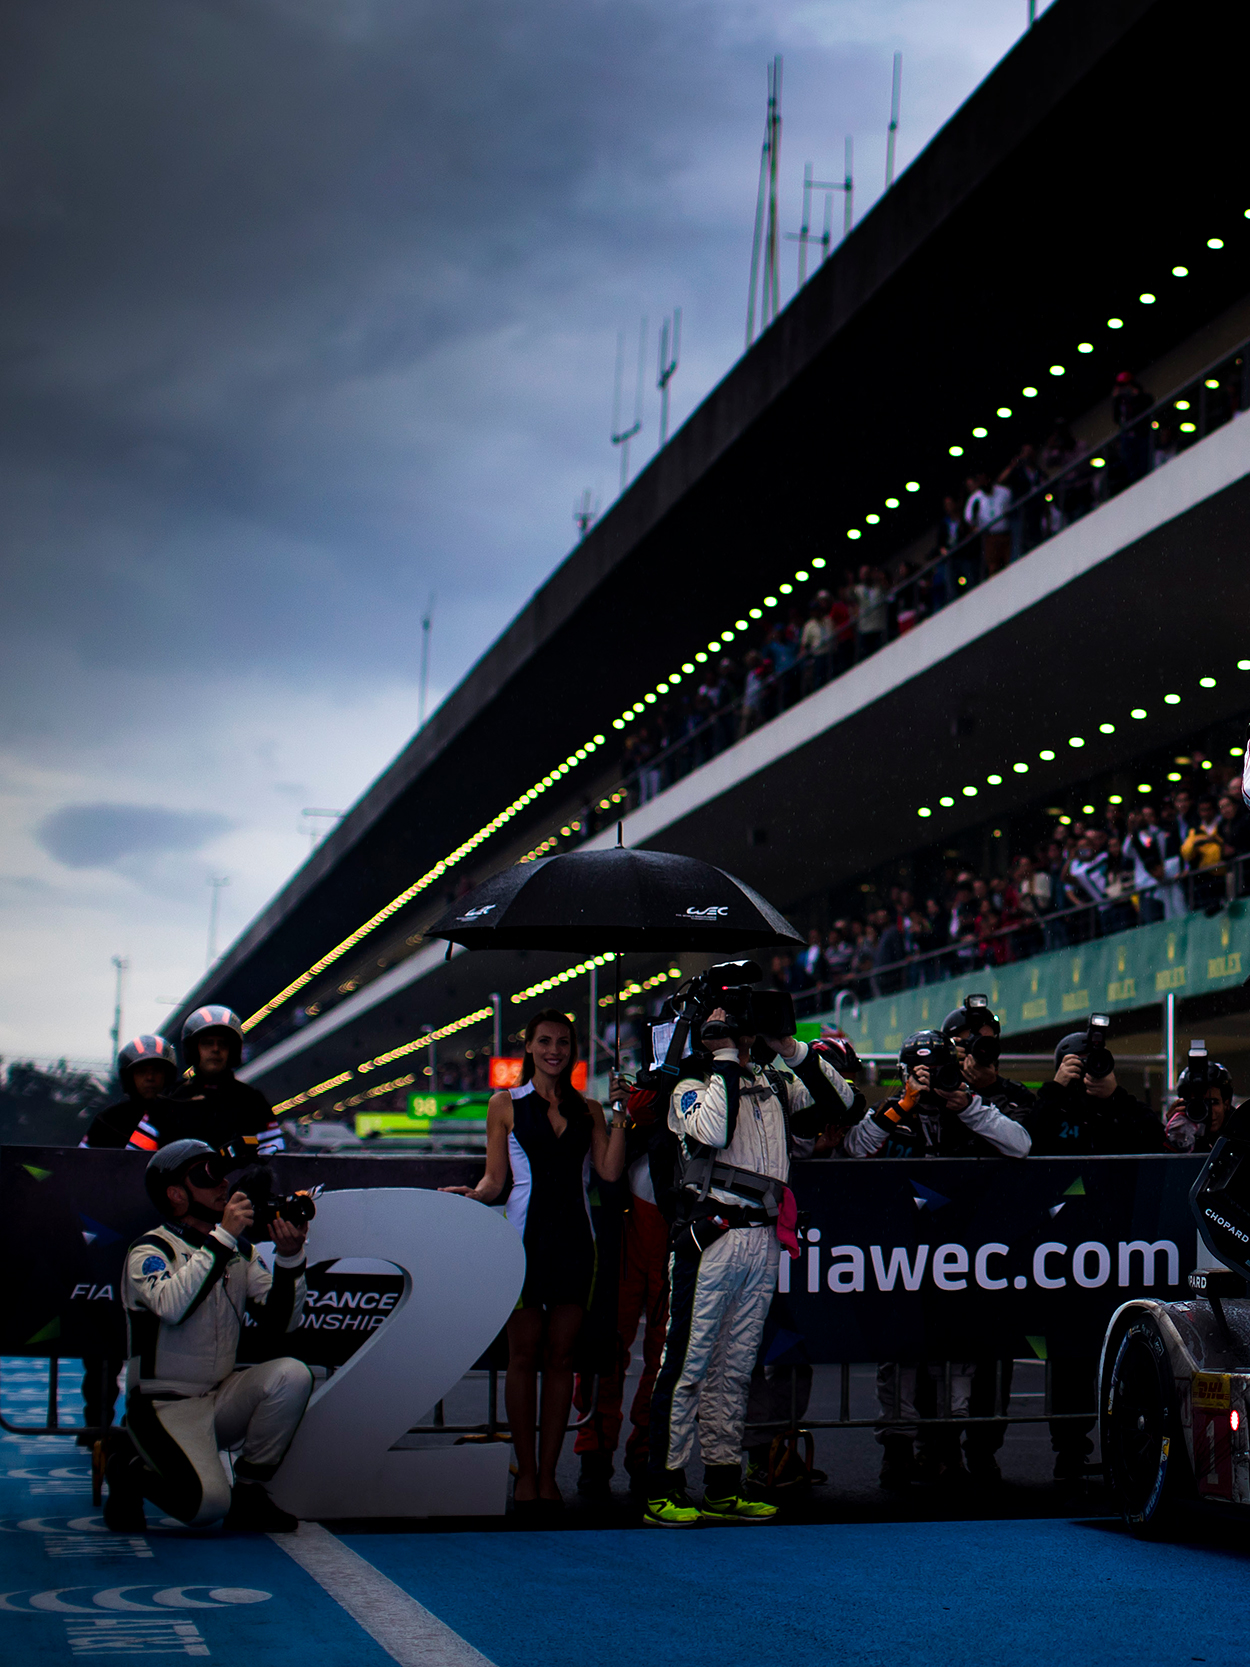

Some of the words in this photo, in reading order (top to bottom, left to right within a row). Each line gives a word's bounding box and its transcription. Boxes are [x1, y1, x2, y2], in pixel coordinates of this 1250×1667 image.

[686, 905, 729, 916] WEC
[1207, 952, 1242, 980] ROLEX
[1204, 1207, 1250, 1244] CHOPARD
[69, 1283, 116, 1302] FIA
[306, 1290, 399, 1310] RANCE
[278, 1186, 526, 1517] 2
[1197, 1381, 1229, 1400] DHL
[1205, 1418, 1220, 1485] 1
